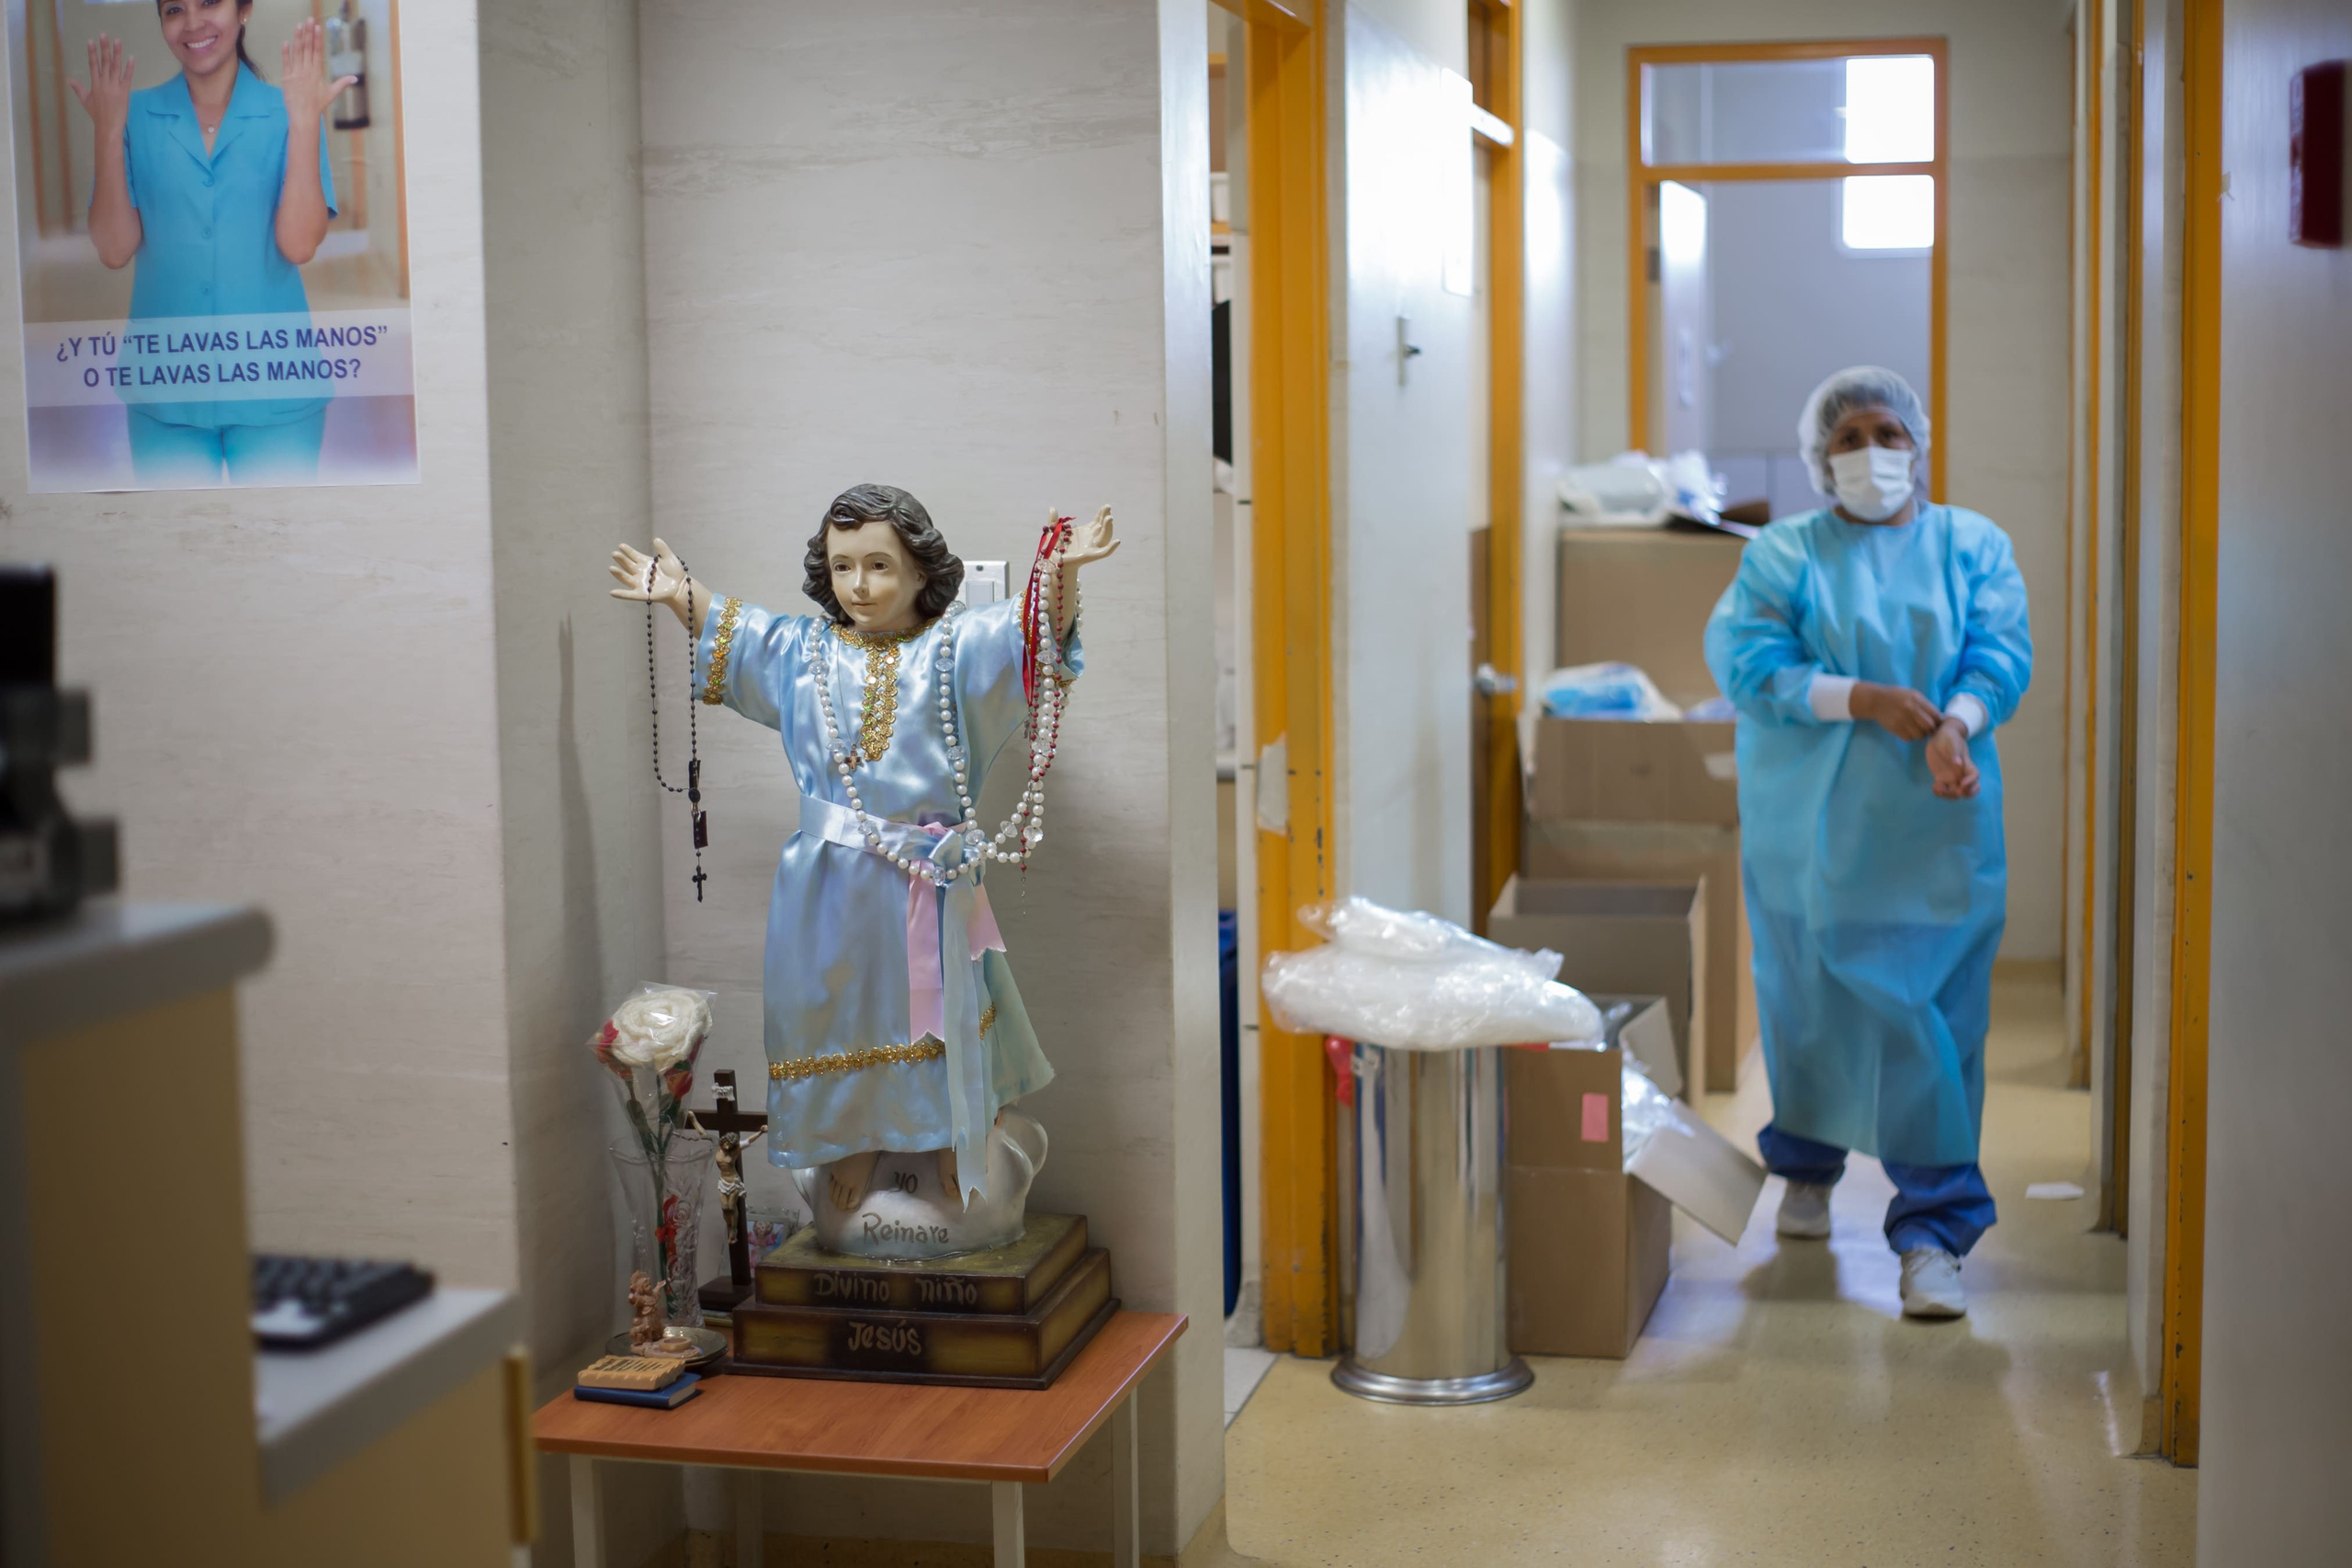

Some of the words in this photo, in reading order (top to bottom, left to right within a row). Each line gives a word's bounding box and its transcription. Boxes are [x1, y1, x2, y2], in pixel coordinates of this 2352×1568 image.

[57, 336, 83, 362] ¿Y
[87, 331, 116, 356] TÚ
[167, 331, 239, 354] LAVAS
[246, 329, 288, 350] LAS
[83, 367, 99, 388] O
[105, 367, 132, 387] TE
[139, 364, 210, 386] LAVAS
[218, 362, 260, 383] LAS
[266, 358, 361, 380] MANOS?
[814, 1270, 890, 1303] Divino
[915, 1276, 978, 1305] niño
[847, 1319, 922, 1356] Jesús
